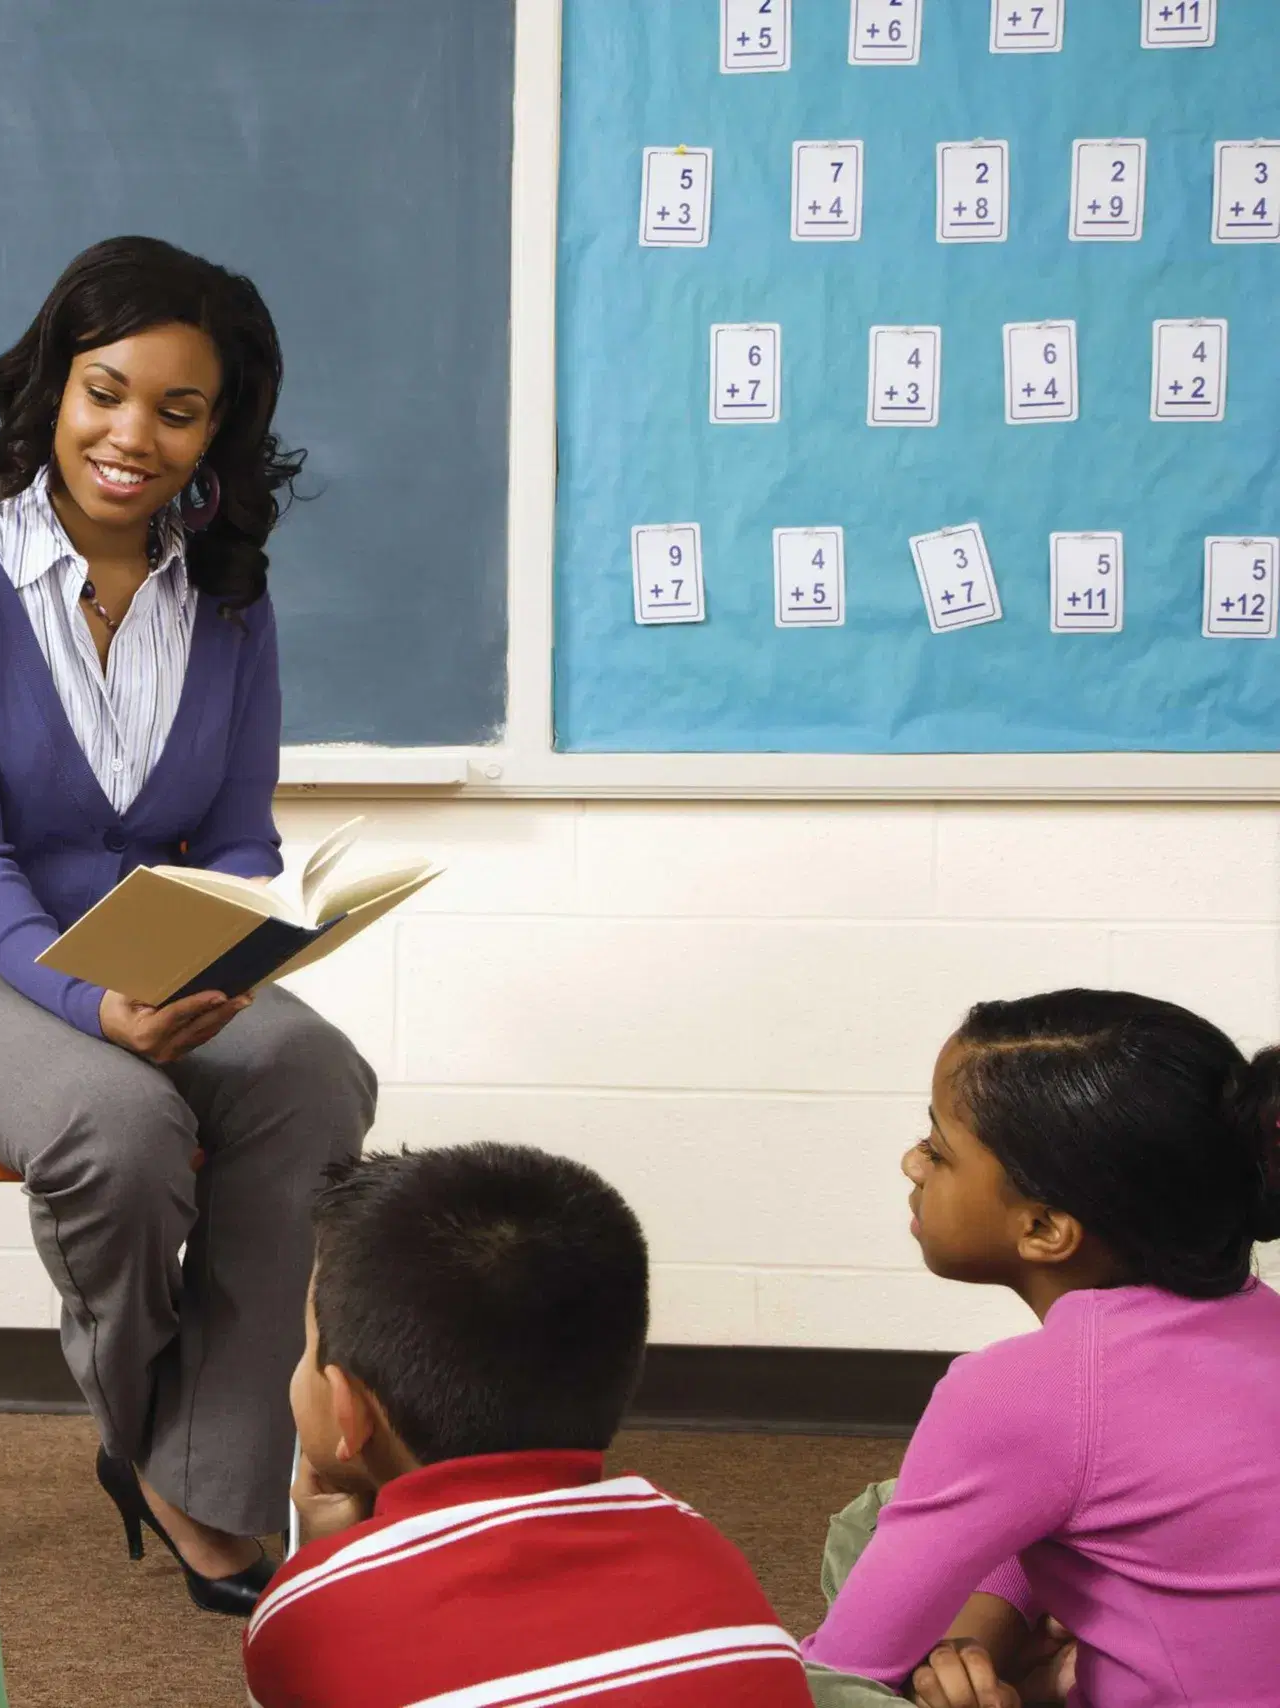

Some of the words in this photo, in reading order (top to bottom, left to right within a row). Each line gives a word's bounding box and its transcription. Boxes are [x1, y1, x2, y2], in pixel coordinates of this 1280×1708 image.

[1158, 0, 1200, 24] +11
[680, 168, 693, 190] 5
[830, 161, 844, 183] 7
[975, 162, 989, 184] 2
[1111, 160, 1125, 182] 2
[1254, 161, 1269, 185] 3
[748, 345, 762, 367] 6
[907, 348, 921, 369] 4
[1043, 343, 1057, 365] 6
[1192, 341, 1207, 363] 4
[669, 545, 682, 567] 9
[811, 548, 825, 569] 4
[953, 548, 969, 569] 3
[1097, 554, 1111, 575] 5
[1252, 559, 1267, 581] 5
[1067, 587, 1106, 610] +11
[1220, 593, 1266, 616] +12
